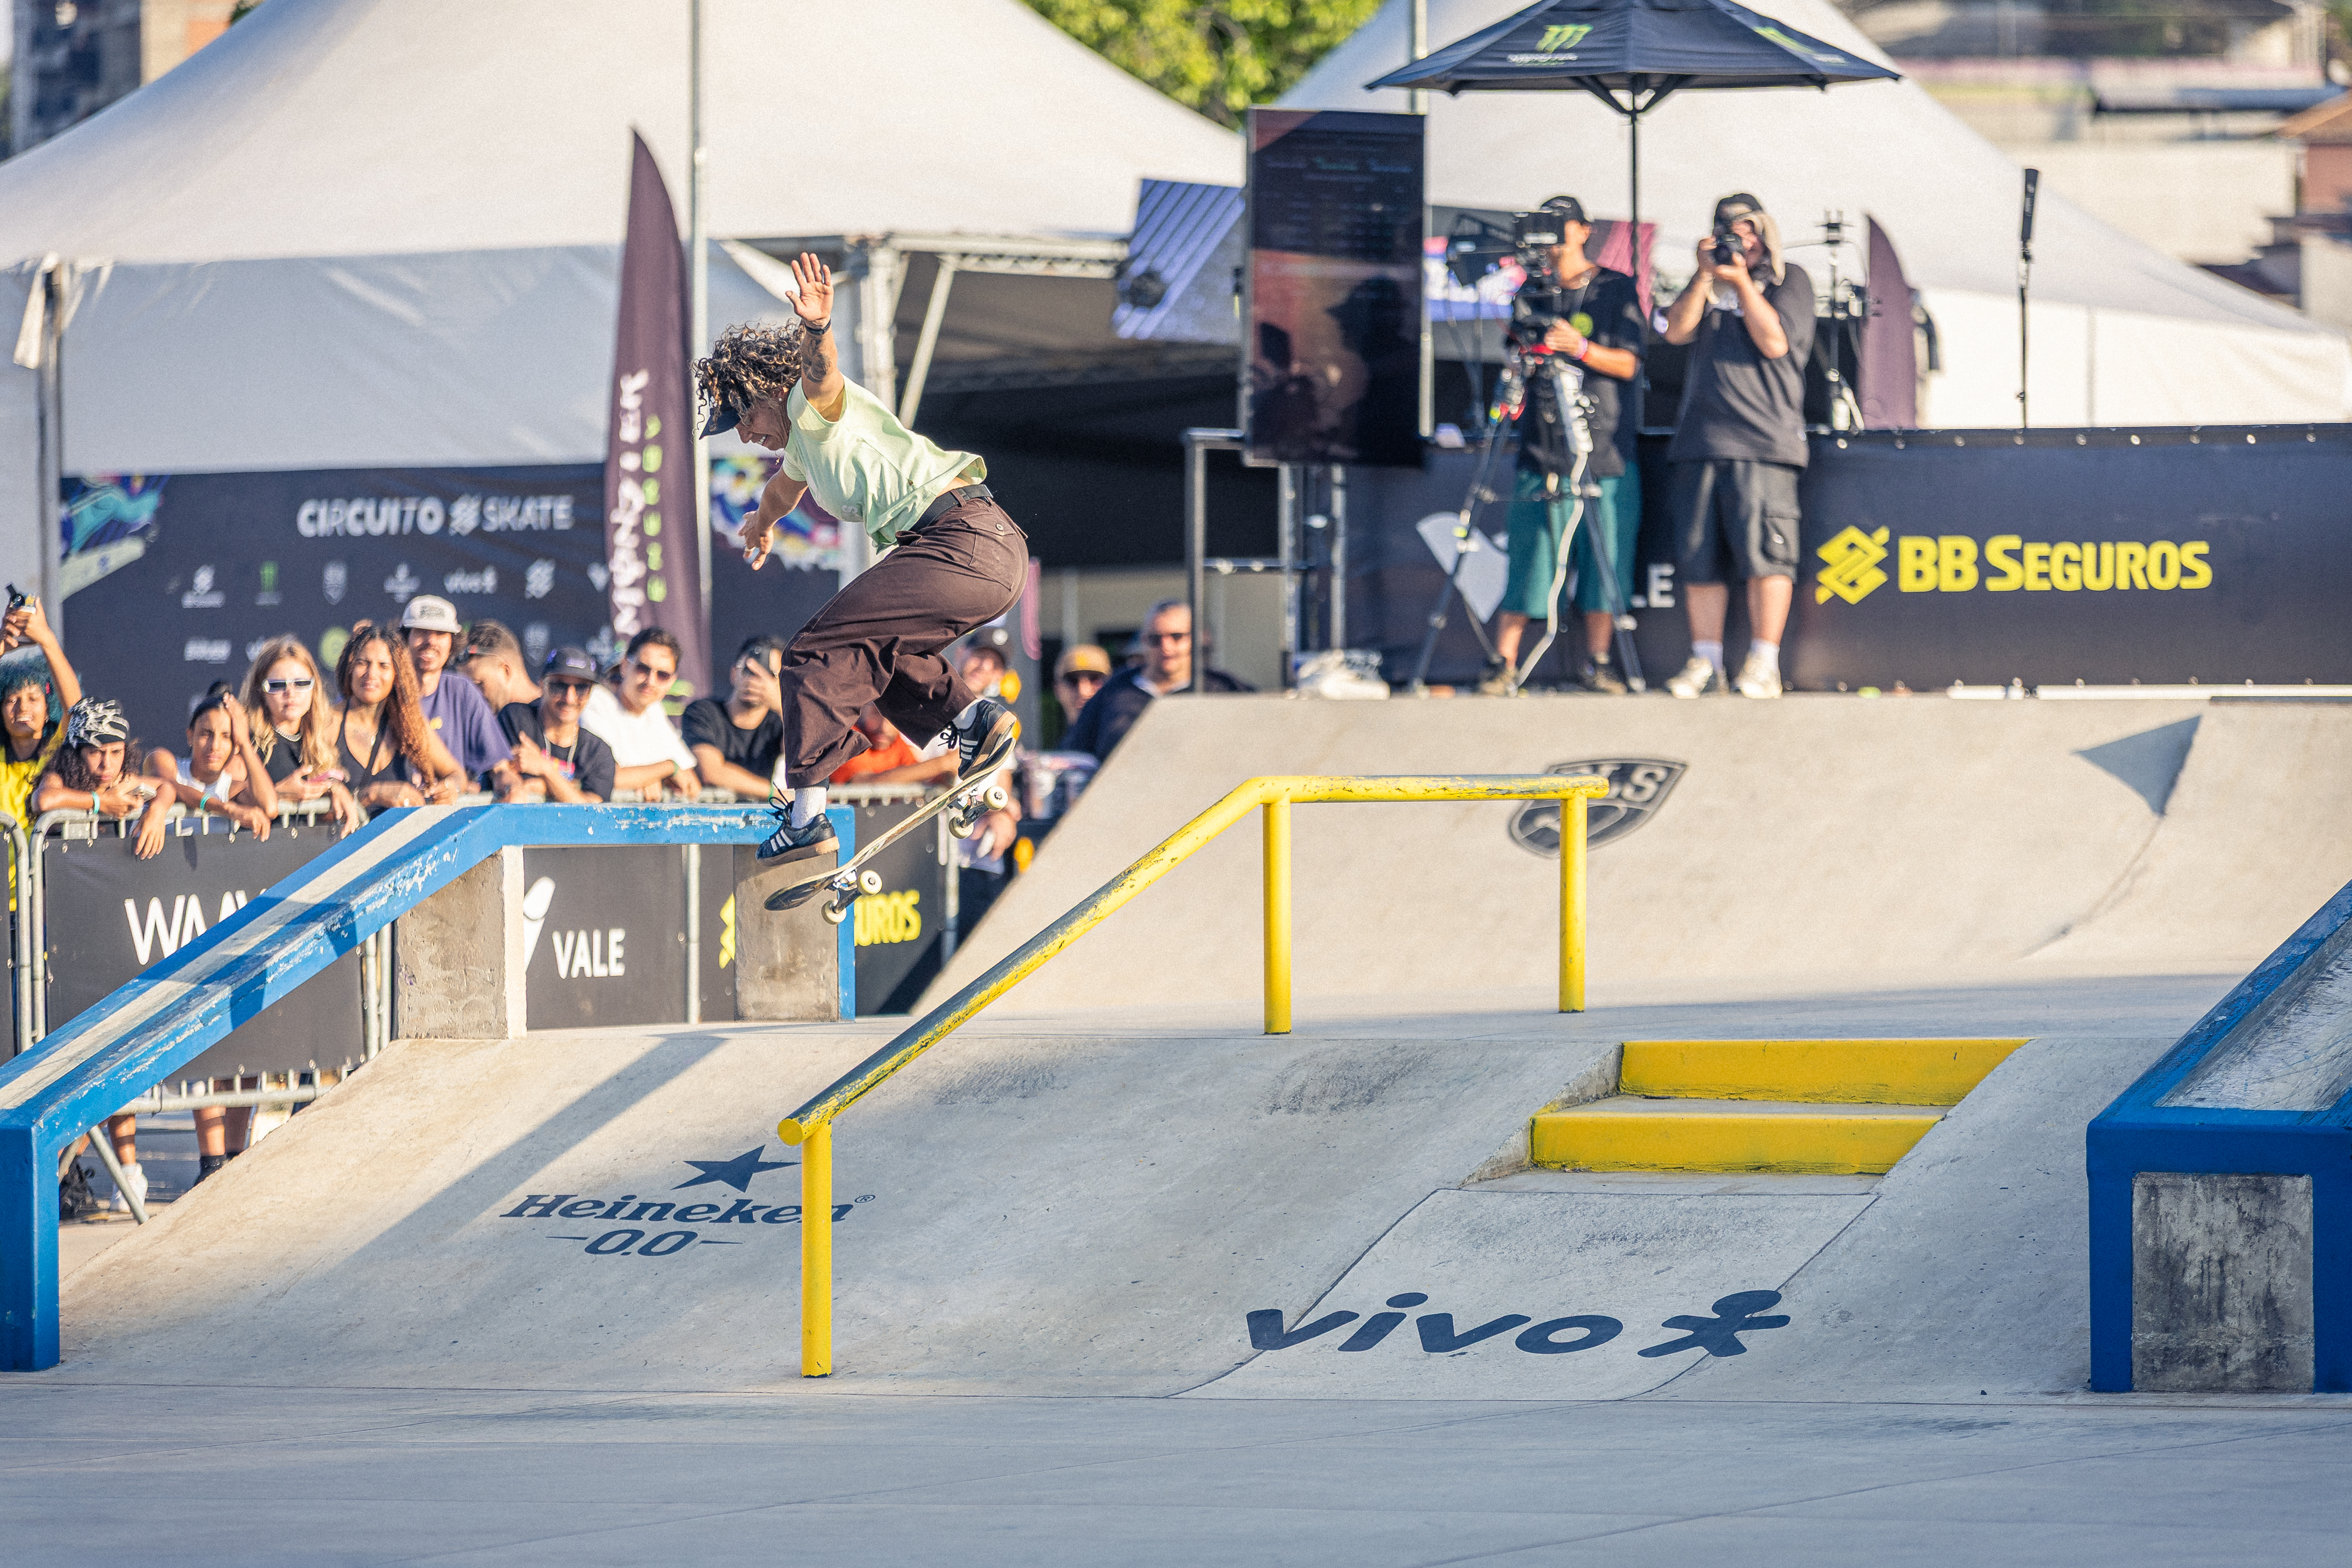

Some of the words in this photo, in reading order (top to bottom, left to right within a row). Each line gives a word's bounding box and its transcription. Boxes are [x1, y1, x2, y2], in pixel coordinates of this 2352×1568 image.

[296, 496, 446, 537] CIRCUITO
[482, 495, 575, 532] SKATE
[1898, 535, 1979, 593] BB
[1985, 534, 2213, 592] SEGUROS
[552, 928, 626, 979] VALE
[1246, 1292, 1624, 1355] vivo
